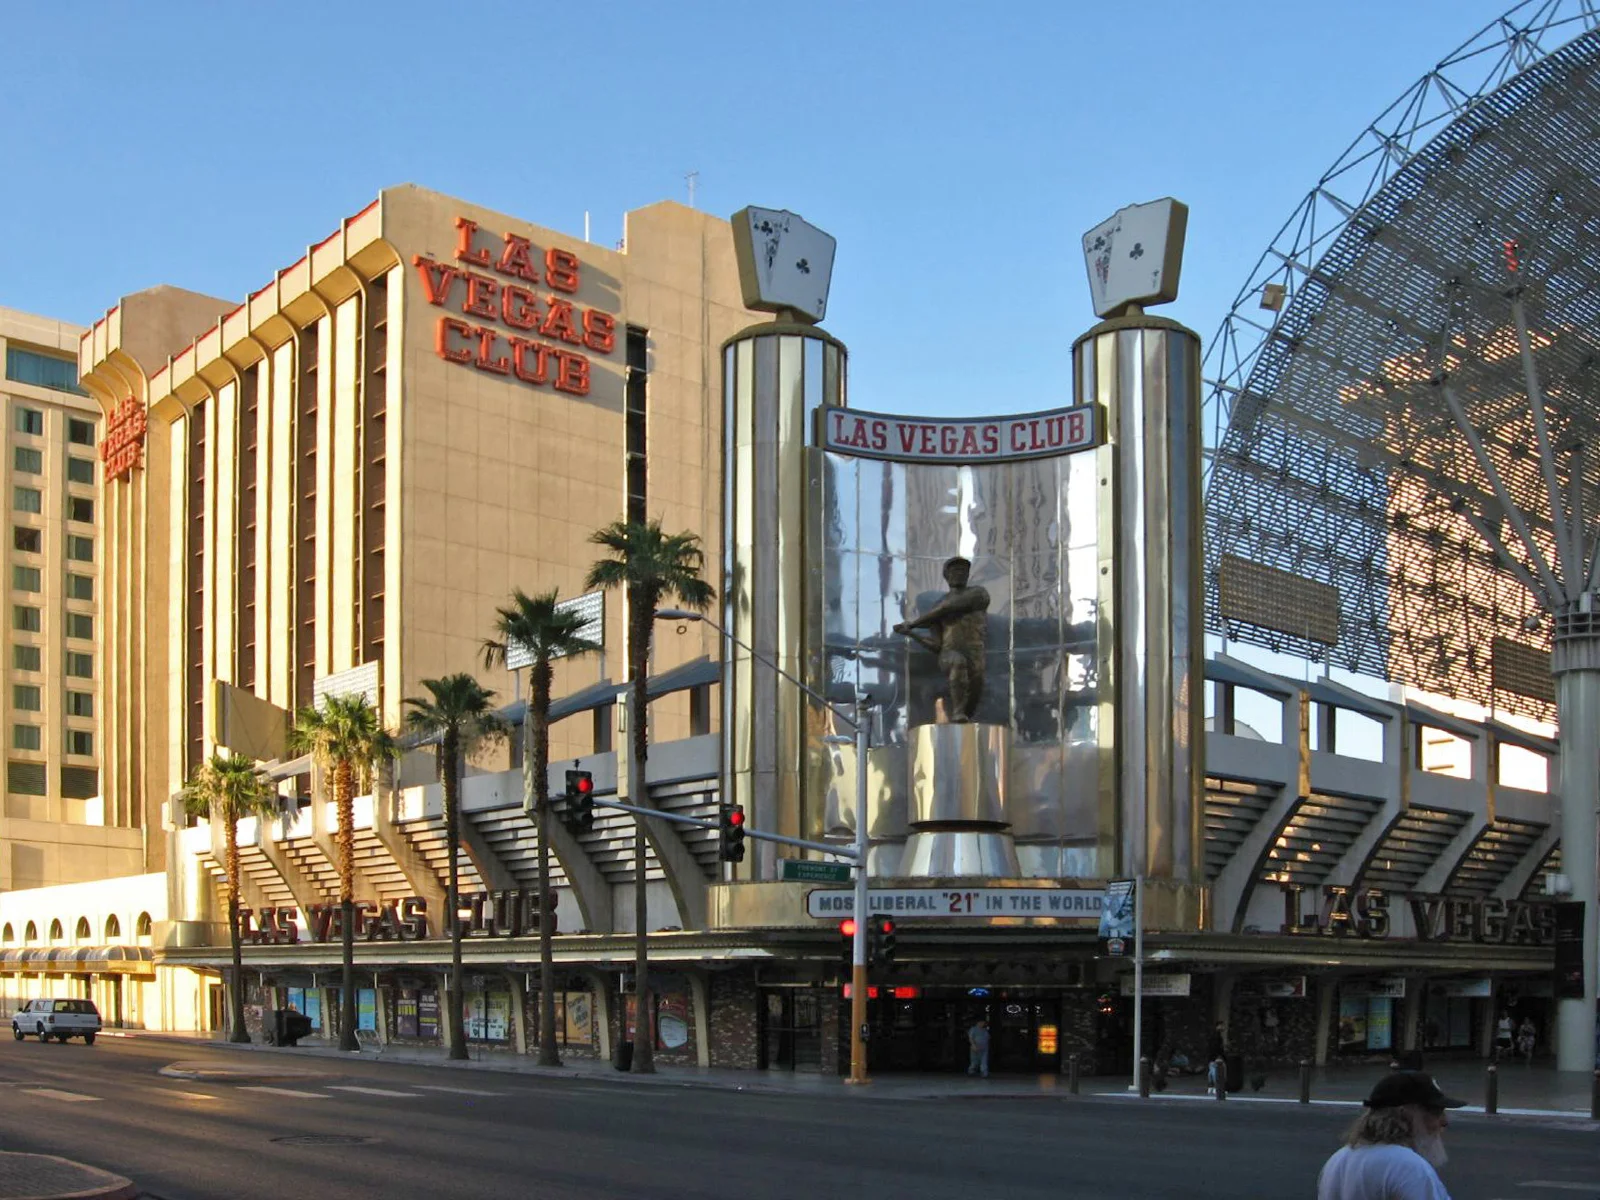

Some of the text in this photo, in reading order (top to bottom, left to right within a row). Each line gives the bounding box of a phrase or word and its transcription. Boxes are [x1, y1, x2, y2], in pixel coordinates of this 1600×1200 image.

[454, 216, 579, 293] LAS
[411, 254, 615, 354] VEGAS
[436, 317, 591, 396] CLUB
[833, 412, 1085, 455] LAS VEGAS CLUB
[239, 906, 298, 945] LAS
[819, 892, 1103, 913] MOS LIBERAL "21" IN THE WORLD
[1280, 882, 1557, 945] LAS VEGAS
